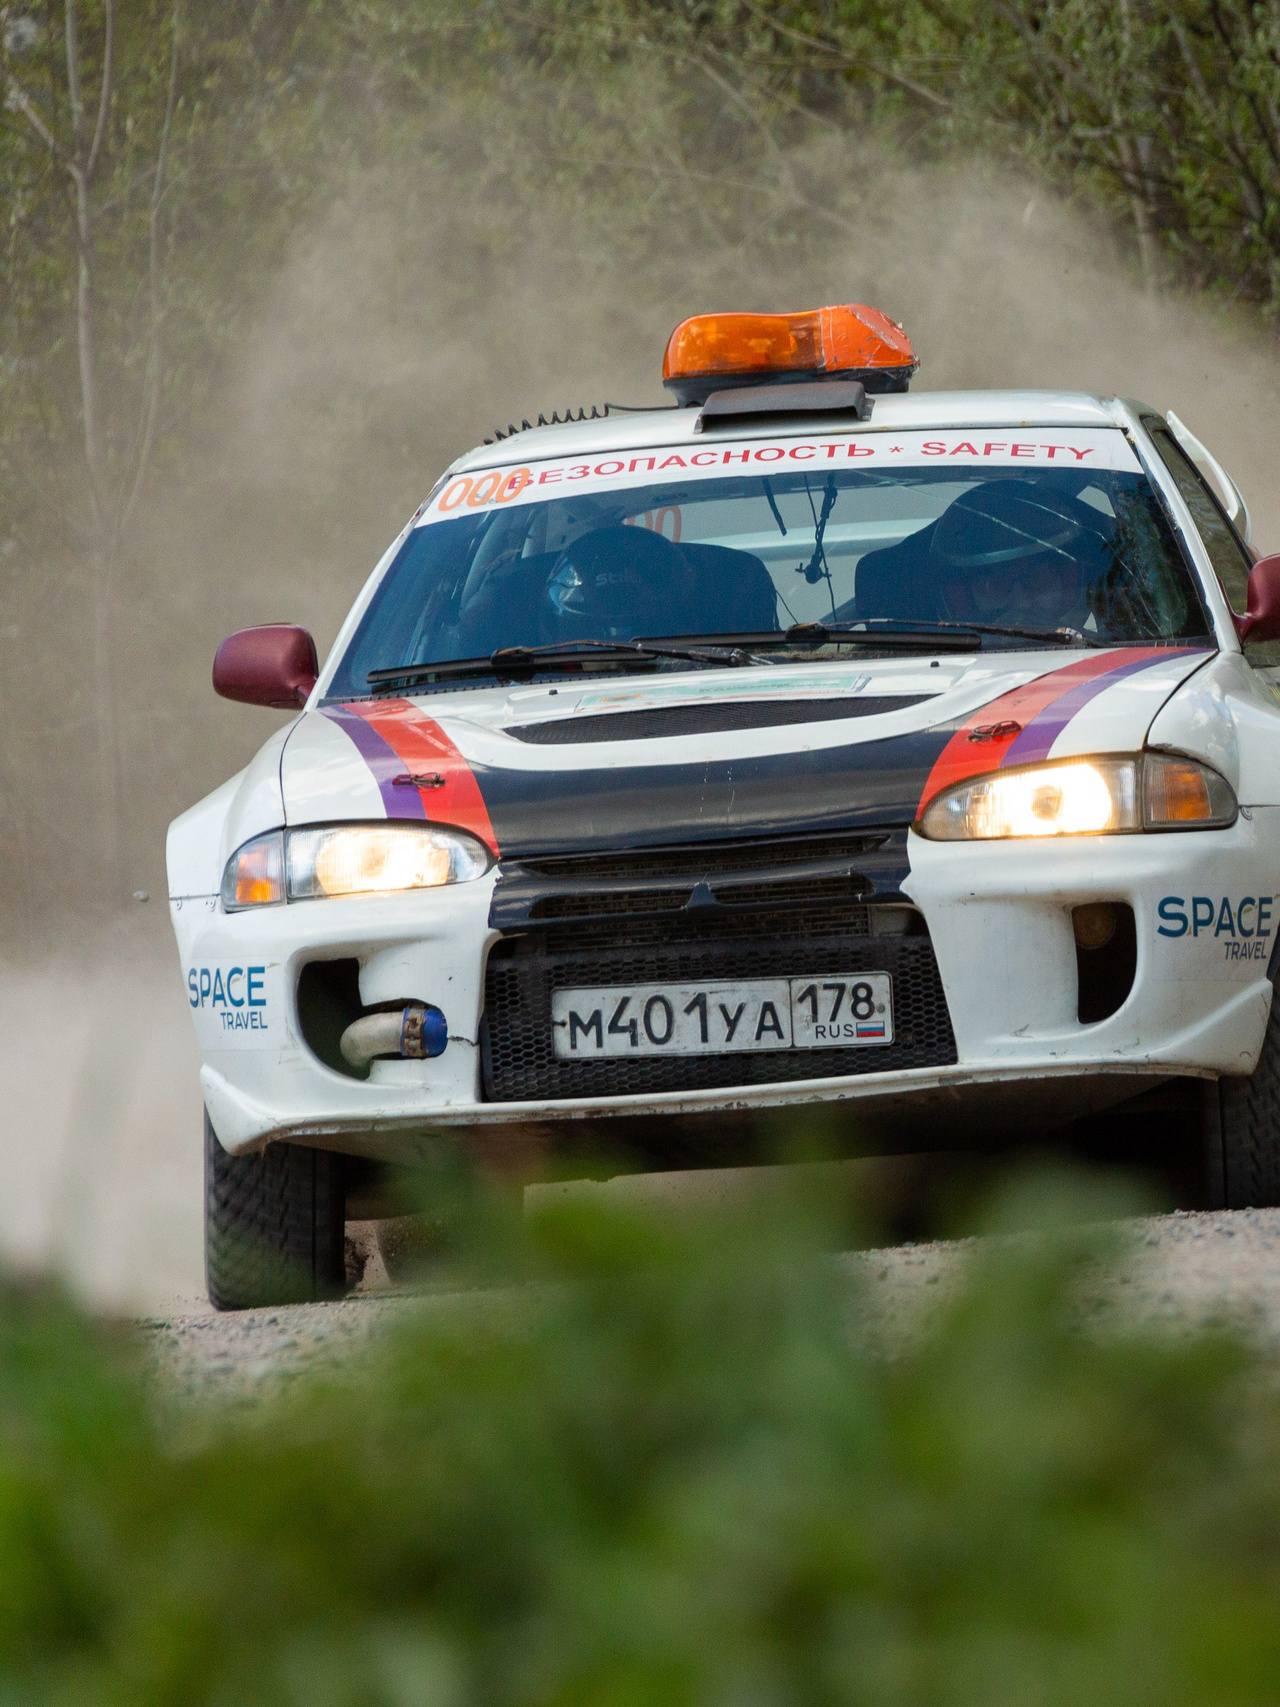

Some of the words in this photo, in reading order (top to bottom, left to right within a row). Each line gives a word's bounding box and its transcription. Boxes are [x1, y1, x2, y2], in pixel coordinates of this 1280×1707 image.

[508, 443, 875, 490] БЕЗОПАСНОСТЬ
[920, 441, 1095, 461] SAFETY
[437, 467, 531, 512] 000
[1157, 896, 1273, 938] SPACE
[1224, 939, 1267, 960] TRAVEL
[187, 966, 267, 1008] SPACE
[796, 982, 876, 1023] 178
[220, 1011, 268, 1030] TRAVEL
[814, 1022, 855, 1040] RUS
